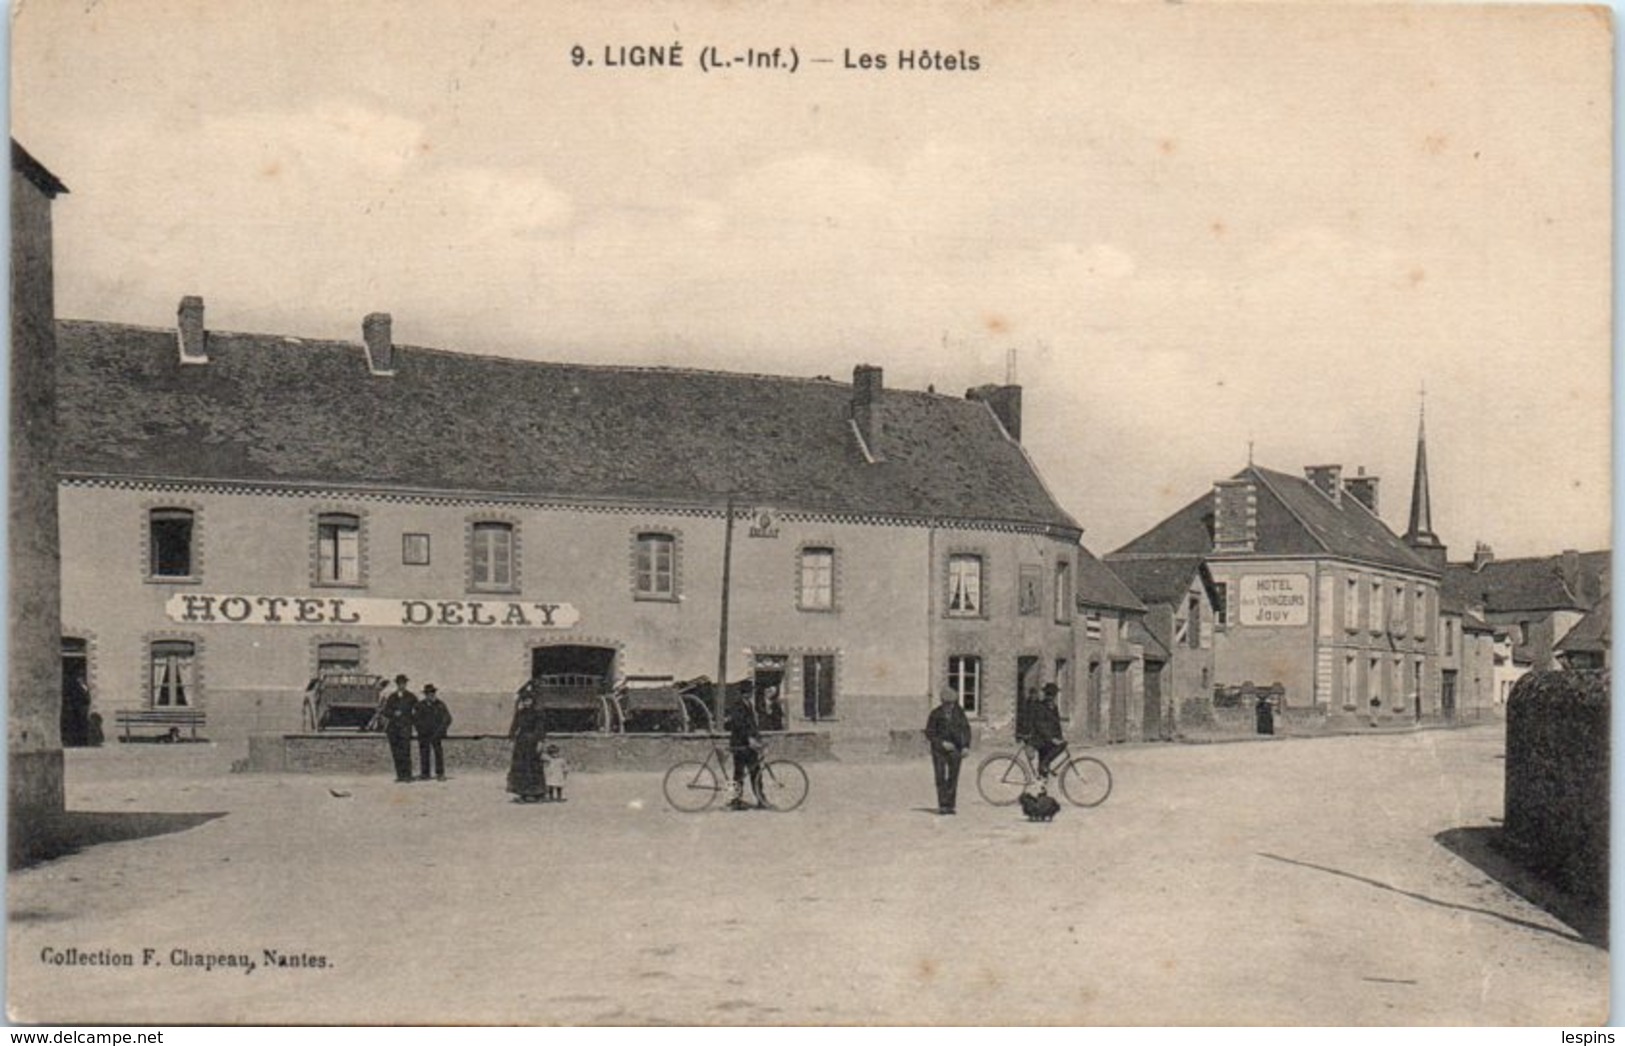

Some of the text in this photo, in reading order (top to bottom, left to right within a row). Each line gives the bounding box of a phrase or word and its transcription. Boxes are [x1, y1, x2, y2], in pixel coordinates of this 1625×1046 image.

[1256, 579, 1293, 591] HOTEL
[181, 595, 561, 627] HOTEL DELAY
